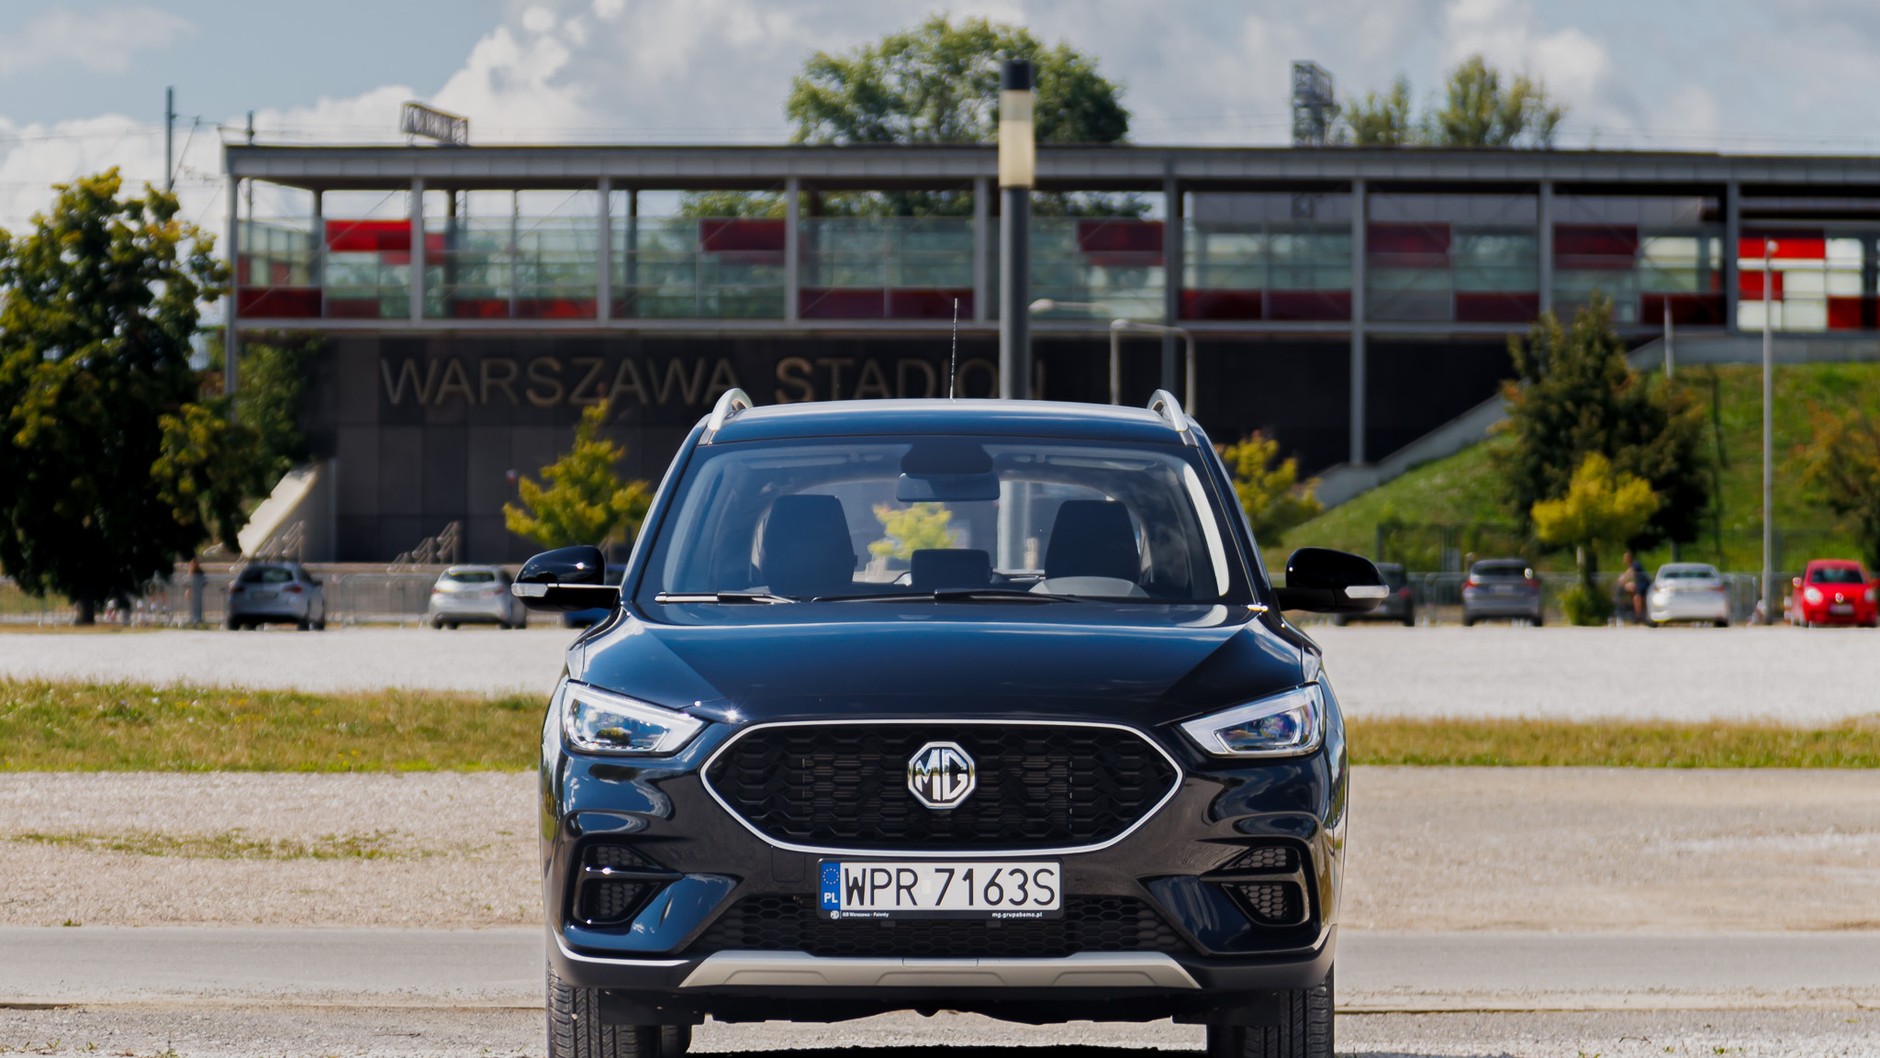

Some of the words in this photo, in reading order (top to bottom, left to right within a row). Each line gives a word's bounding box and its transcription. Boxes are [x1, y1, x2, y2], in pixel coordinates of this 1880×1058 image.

[379, 356, 742, 406] WARSZAWA
[914, 748, 968, 801] MG
[823, 892, 839, 904] PL
[844, 868, 918, 906] WPR
[934, 868, 1056, 906] 7163S
